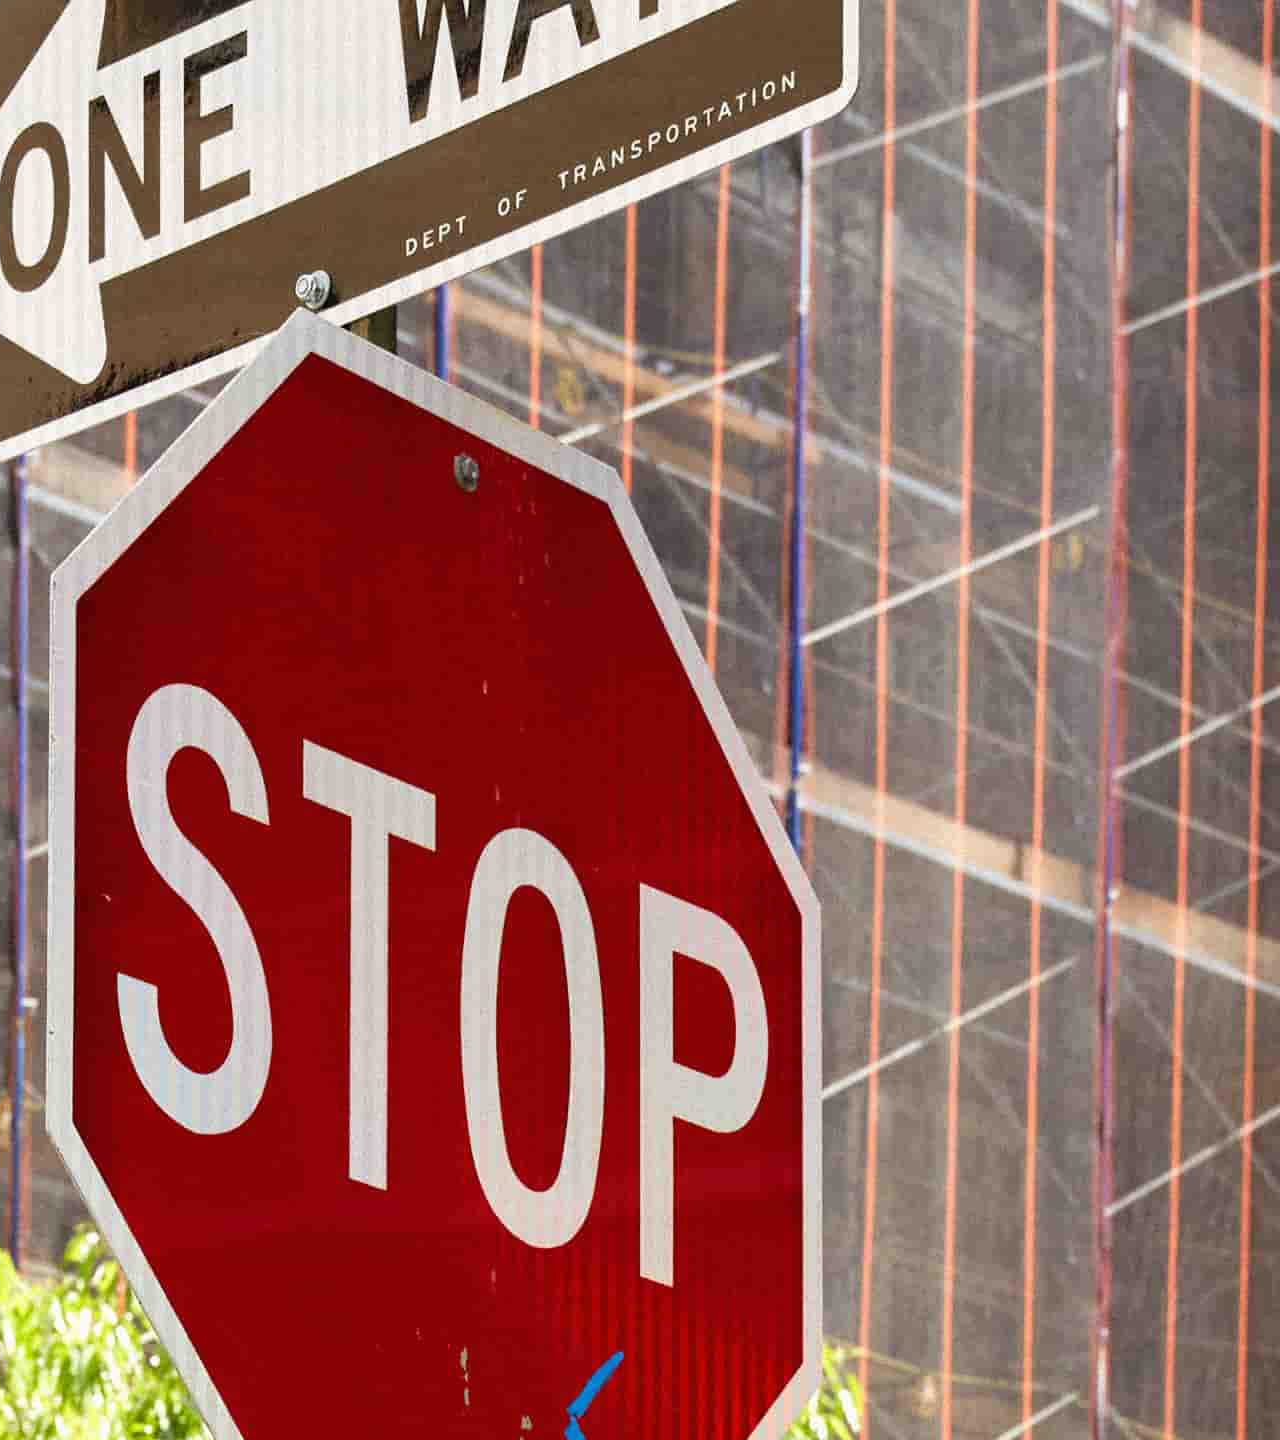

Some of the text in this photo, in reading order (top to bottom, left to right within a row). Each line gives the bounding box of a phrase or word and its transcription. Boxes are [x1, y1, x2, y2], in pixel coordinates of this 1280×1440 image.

[398, 0, 659, 124] WA
[405, 71, 797, 257] DEPT OF TRANSPORTATION
[117, 683, 768, 1288] STOP
